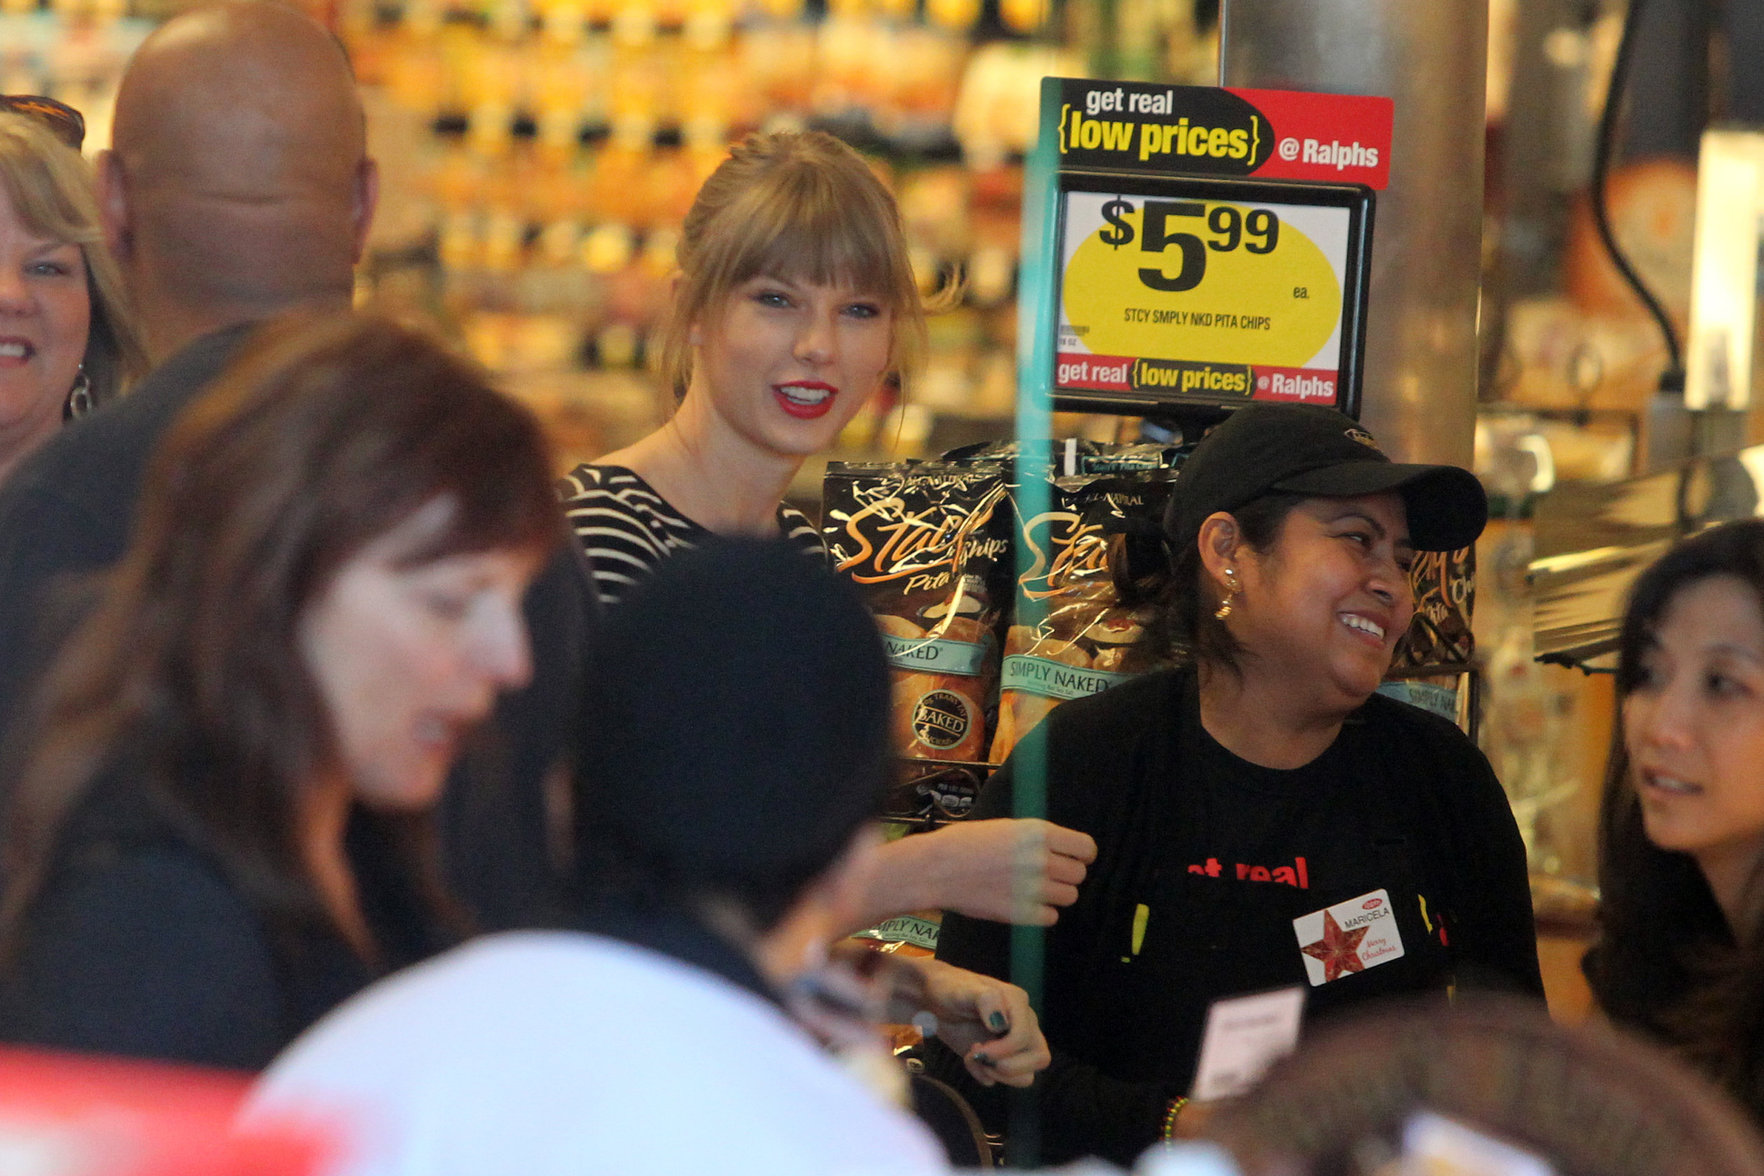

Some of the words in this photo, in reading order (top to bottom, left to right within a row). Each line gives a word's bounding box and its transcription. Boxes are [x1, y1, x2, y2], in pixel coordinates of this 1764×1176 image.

[1086, 89, 1124, 115] get
[1128, 90, 1173, 114] real
[1292, 286, 1310, 300] ea.
[1124, 308, 1151, 324] STCY
[1152, 309, 1189, 326] SMPLY
[1190, 311, 1213, 328] NKD
[1214, 313, 1239, 329] PITA
[1240, 315, 1272, 331] CHIPS
[1057, 359, 1089, 382] get
[1091, 361, 1128, 384] real
[903, 571, 951, 596] Pita
[1010, 661, 1052, 681] SIMPLY
[1344, 907, 1390, 928] MARICELA
